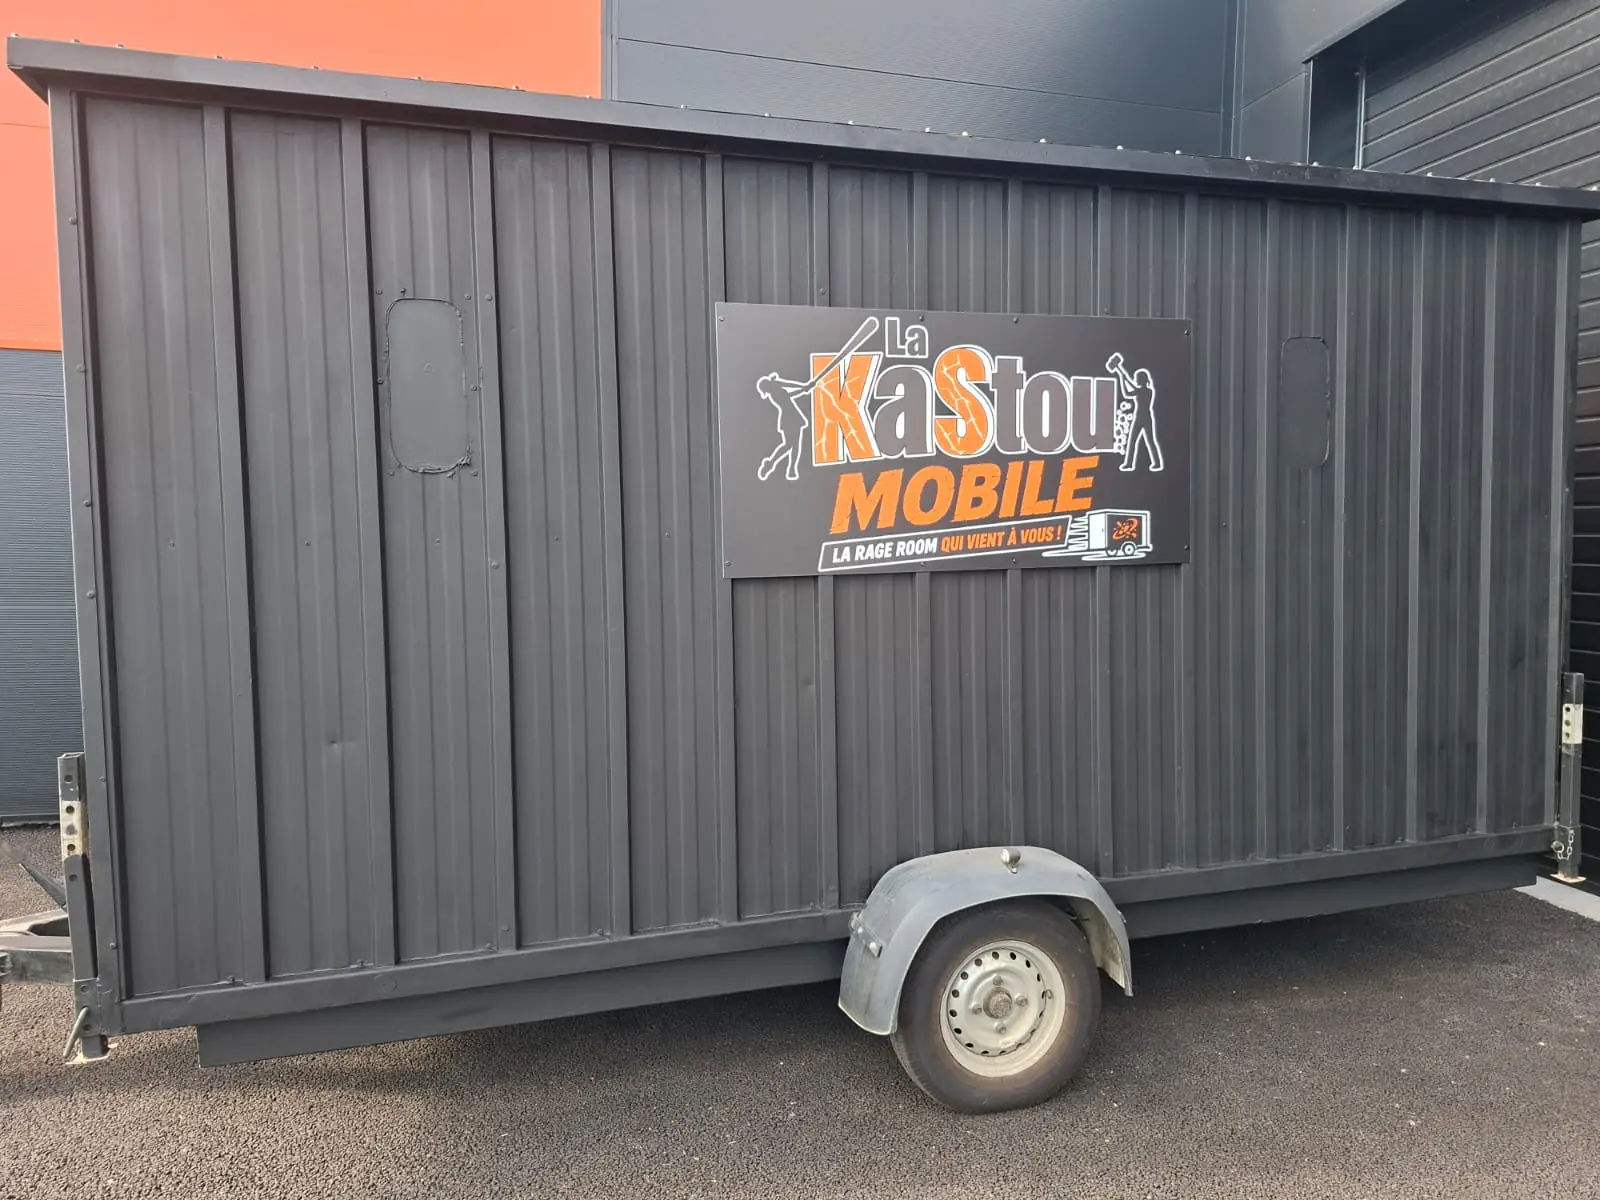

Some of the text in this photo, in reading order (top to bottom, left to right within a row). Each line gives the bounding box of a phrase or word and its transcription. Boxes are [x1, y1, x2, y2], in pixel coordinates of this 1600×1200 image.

[884, 317, 928, 358] La
[809, 345, 1119, 466] KaStou
[829, 455, 1101, 534] MOBILE
[832, 545, 851, 563] LA
[854, 541, 892, 562] RAGE
[895, 537, 938, 558] ROOM
[940, 536, 964, 553] QUI
[966, 532, 1005, 551] VIENT
[1006, 527, 1018, 545] À
[1020, 527, 1055, 544] VOUS
